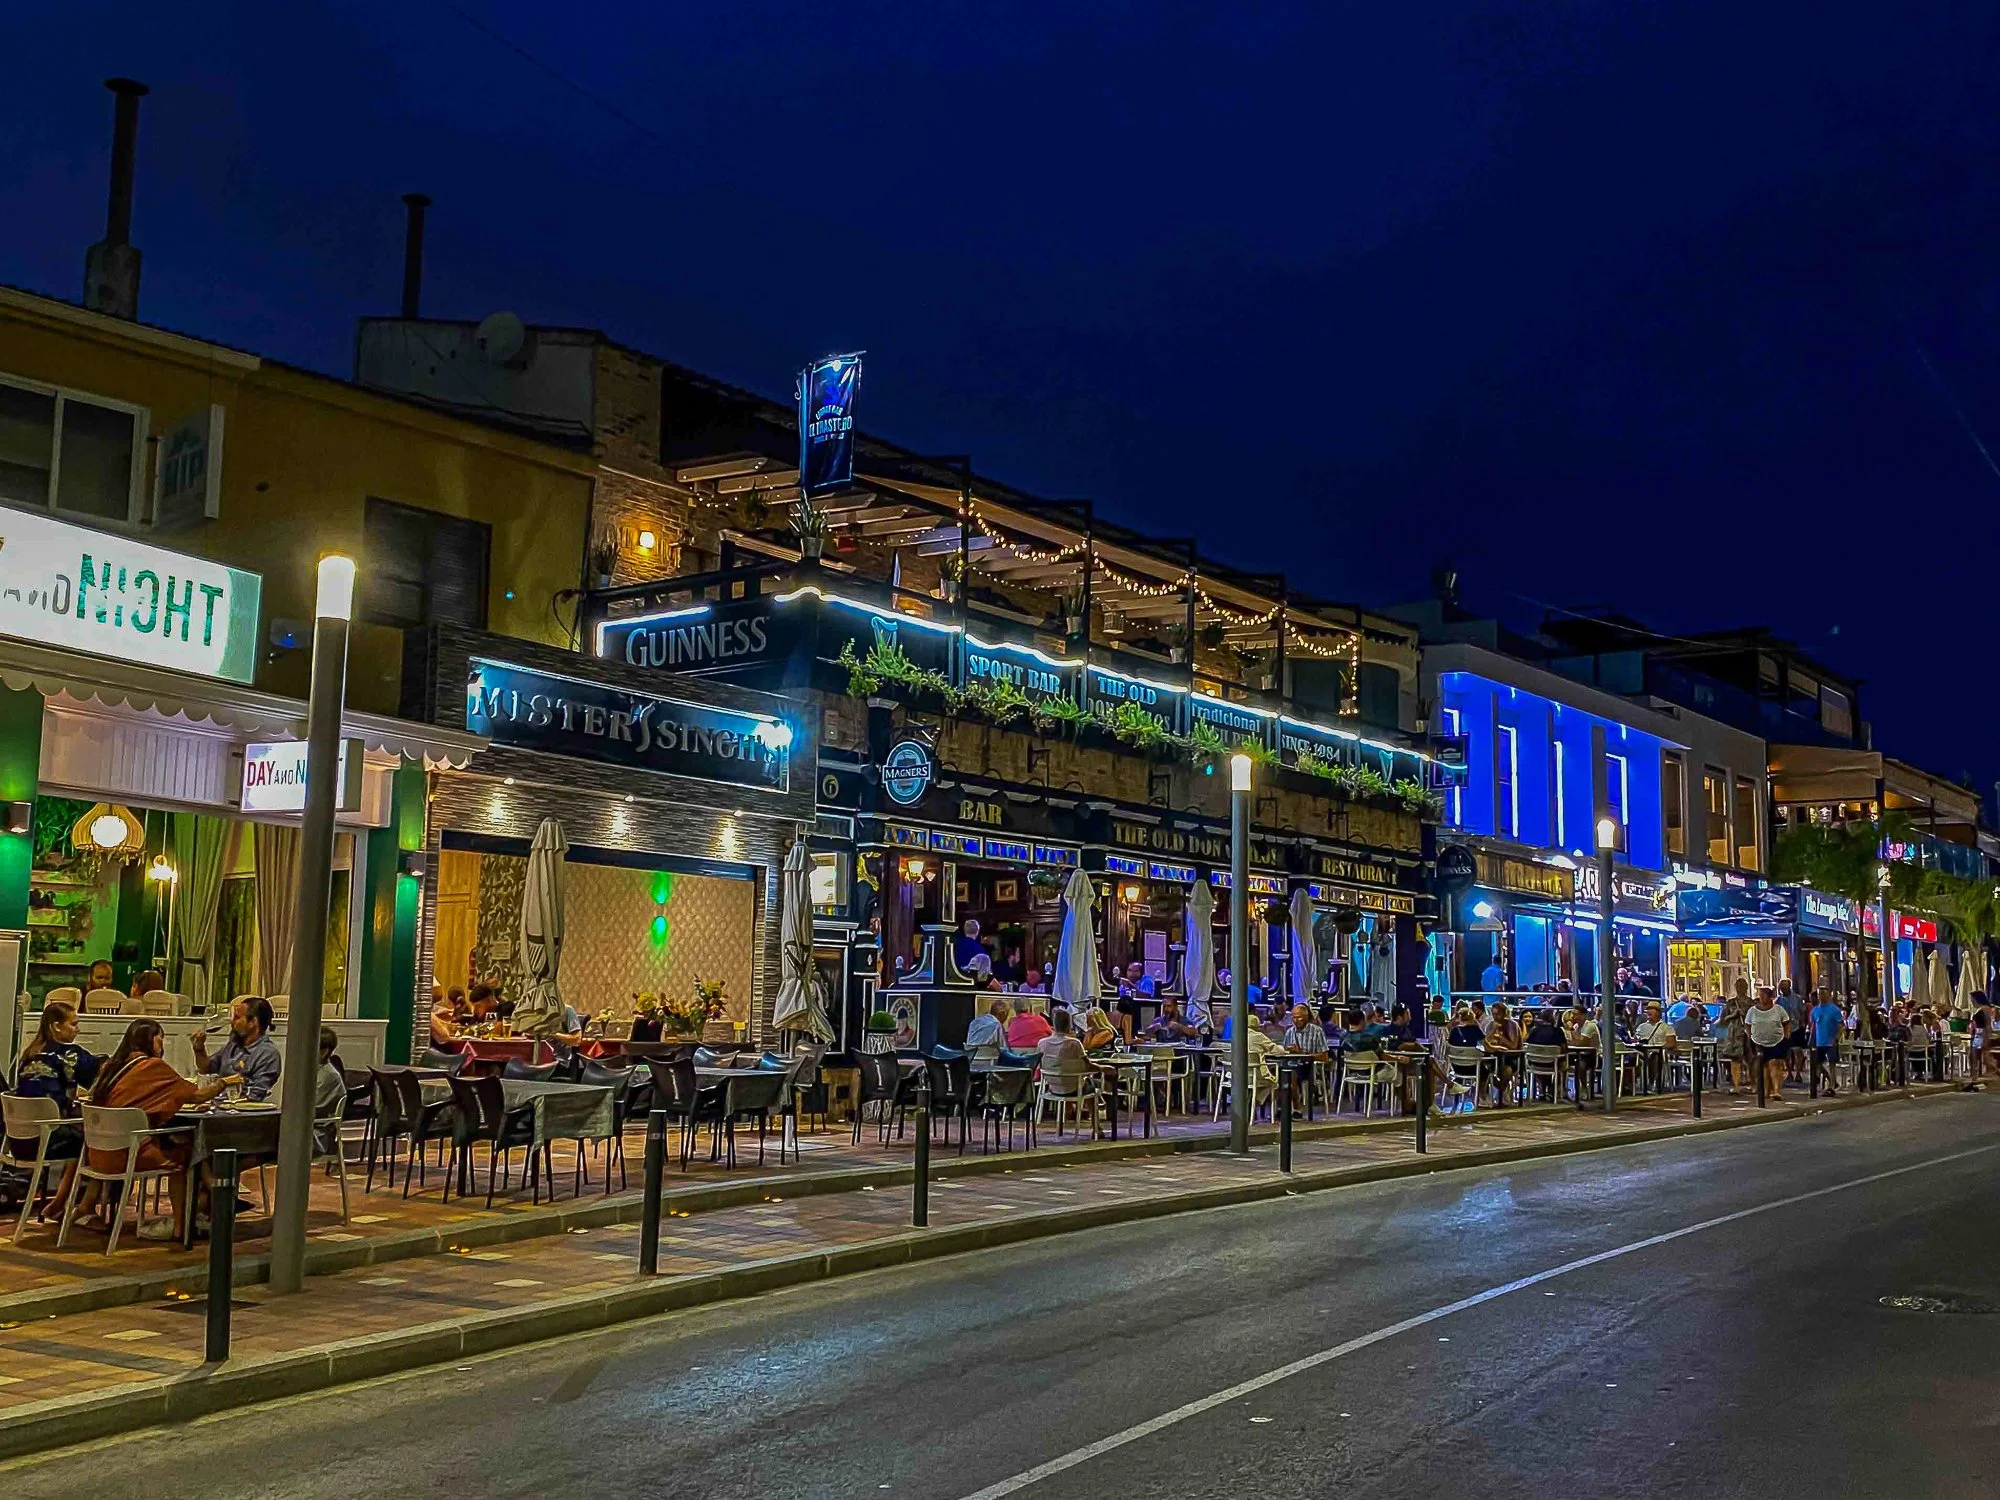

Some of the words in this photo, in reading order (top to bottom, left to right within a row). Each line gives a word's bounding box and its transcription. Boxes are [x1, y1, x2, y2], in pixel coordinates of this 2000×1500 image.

[625, 616, 767, 667] GUINNESS
[969, 654, 1024, 686] SPORT
[1027, 669, 1060, 695] BAR
[1098, 676, 1126, 698] THE
[1129, 684, 1157, 706] OLD
[246, 760, 276, 787] DAY
[885, 766, 929, 779] MAGNERS
[958, 800, 1002, 825] BAR
[1113, 822, 1148, 847] THE
[1151, 829, 1185, 851] OLD
[1188, 835, 1222, 858] DON
